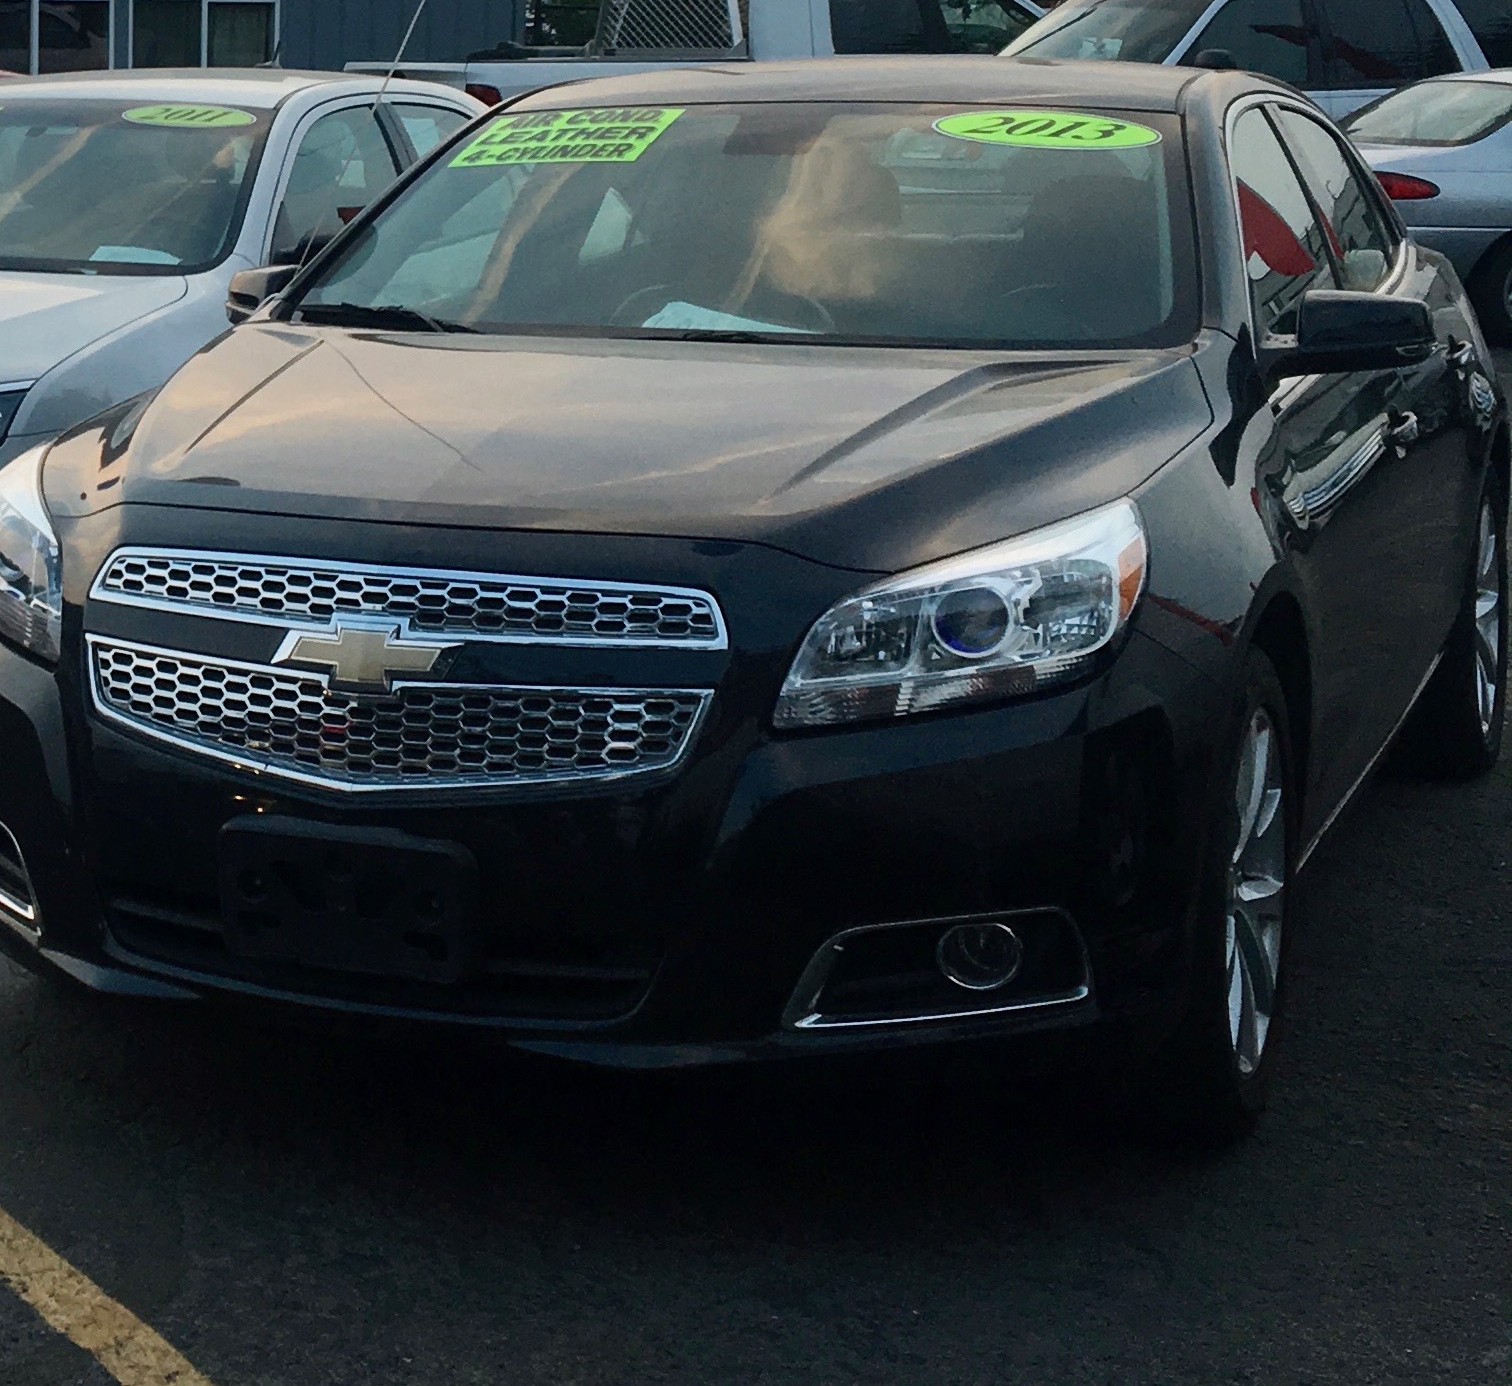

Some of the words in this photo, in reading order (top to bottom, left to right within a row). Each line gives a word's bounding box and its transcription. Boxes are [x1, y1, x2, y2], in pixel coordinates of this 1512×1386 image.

[475, 126, 658, 146] LEATHER
[962, 116, 1126, 140] 2013
[462, 142, 635, 164] 4-CYLINDER
